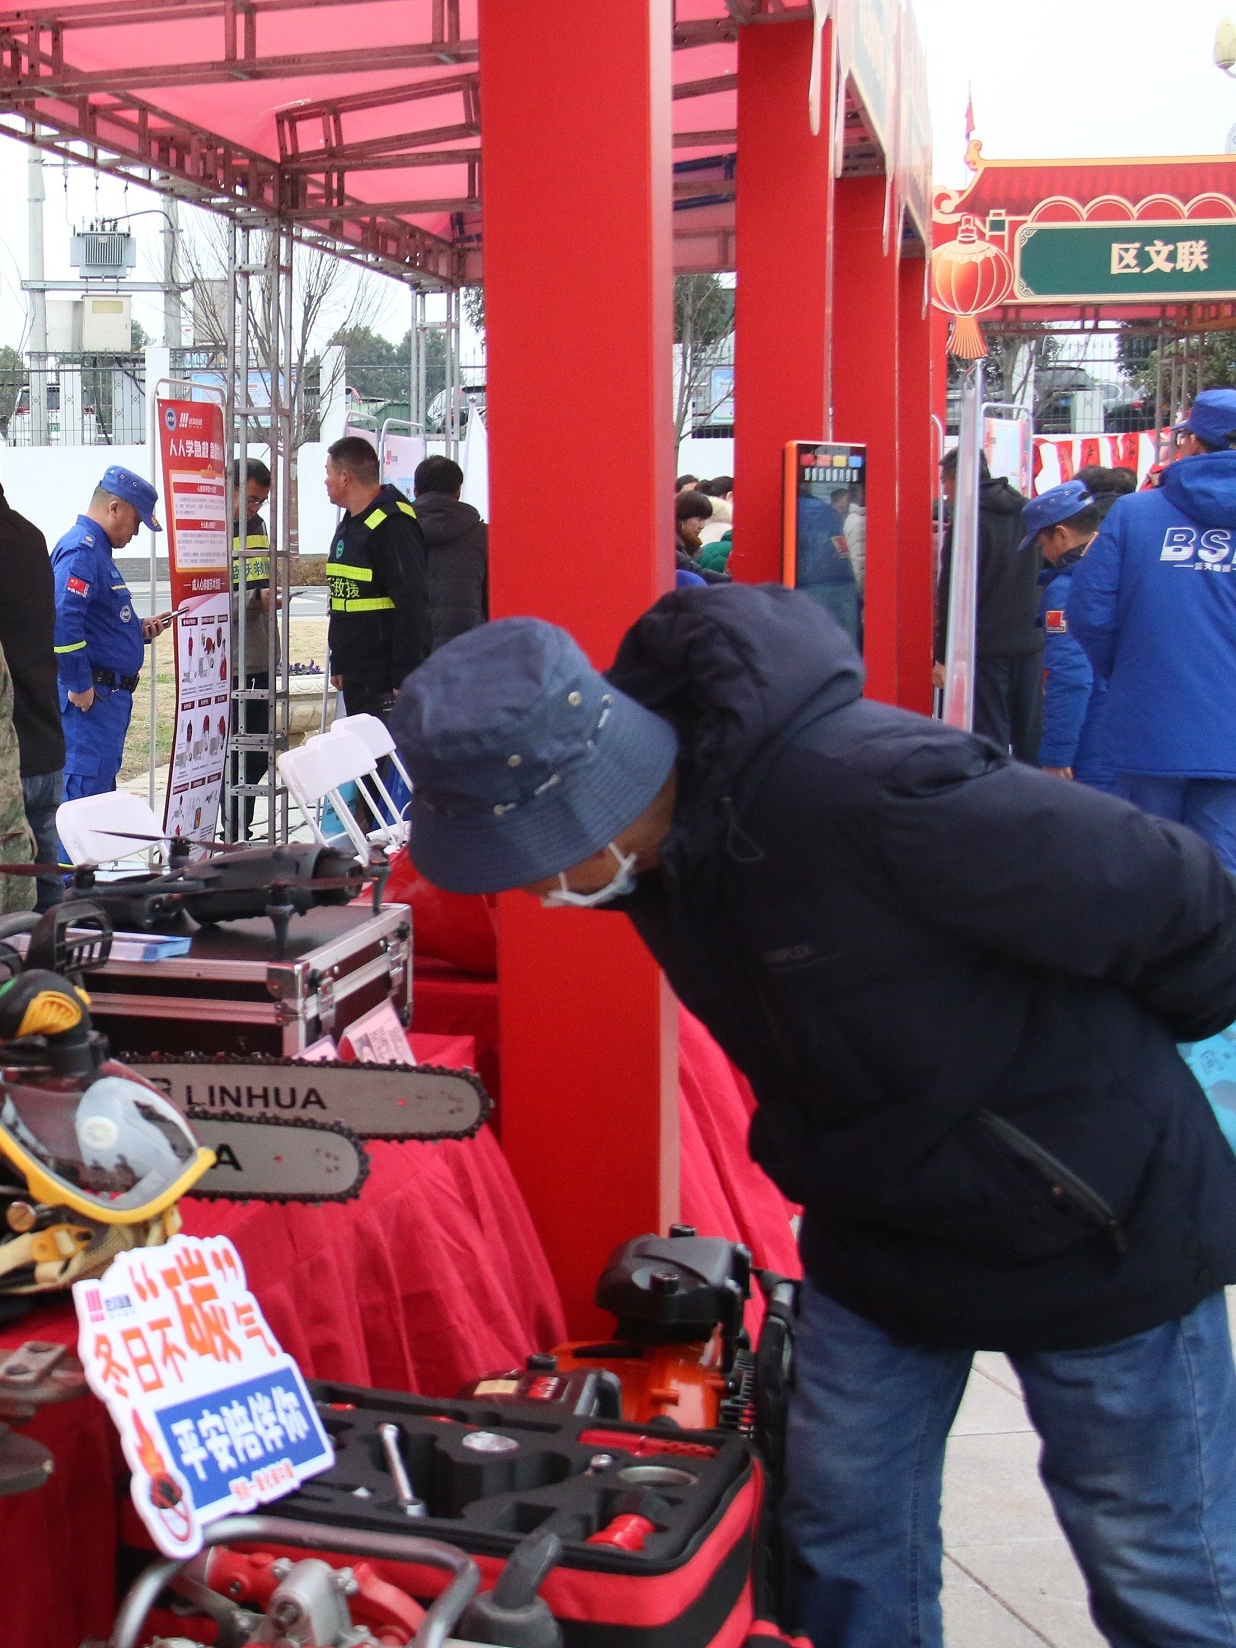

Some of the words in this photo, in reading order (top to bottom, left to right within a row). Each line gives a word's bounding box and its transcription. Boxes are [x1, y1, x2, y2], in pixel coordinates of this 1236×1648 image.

[1110, 240, 1209, 275] 区文联
[169, 438, 209, 458] 人人学急救
[185, 1084, 328, 1111] LINHUA
[170, 1385, 310, 1482] 平安陪伴你
